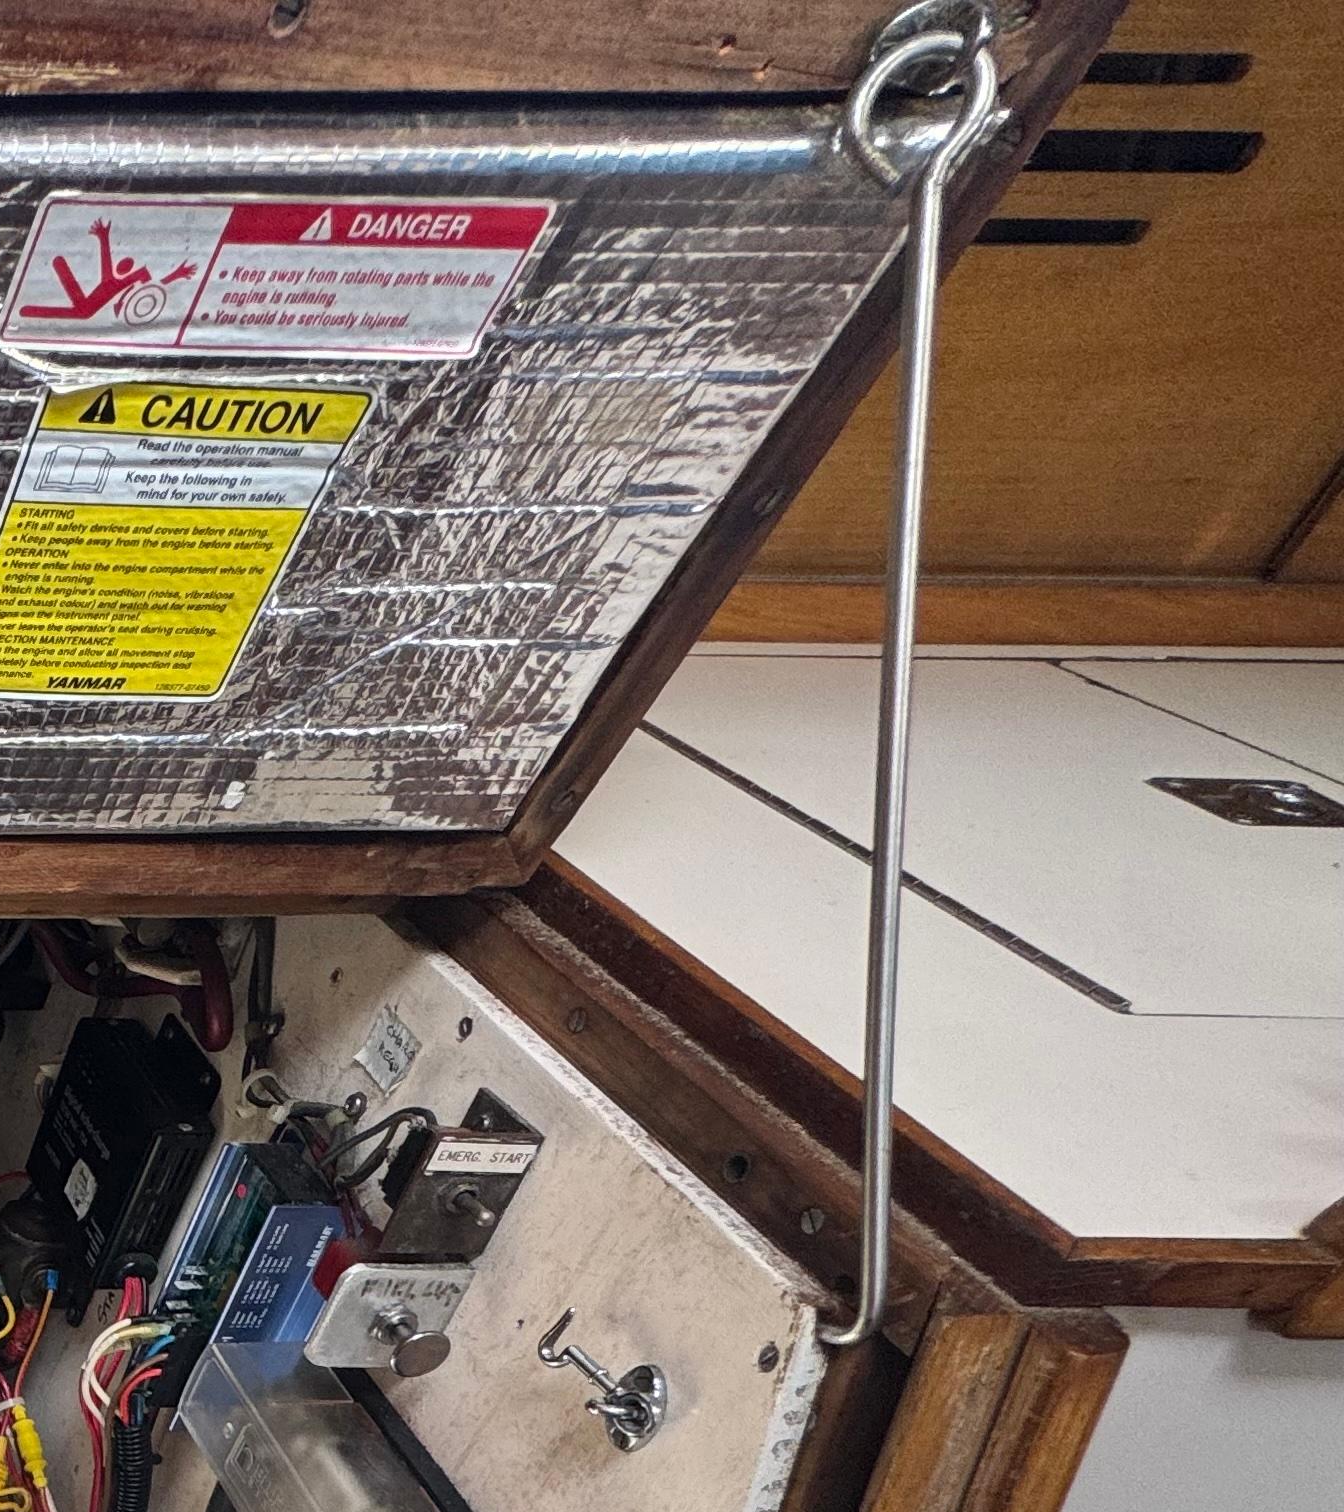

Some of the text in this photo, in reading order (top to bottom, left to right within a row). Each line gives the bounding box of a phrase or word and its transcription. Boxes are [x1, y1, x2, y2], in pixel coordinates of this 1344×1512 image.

[347, 212, 473, 242] DANGER
[232, 267, 494, 287] Keep away from rotating parts while the
[222, 290, 336, 308] engine is running.
[214, 311, 409, 329] You could be seriously injured.
[141, 395, 324, 435] CAUTION
[137, 438, 304, 459] Read the operation manual
[124, 472, 252, 489] Keep the following in
[136, 488, 287, 505] mind for your own safety.
[19, 508, 75, 519] STARTING
[40, 521, 55, 531] all
[56, 522, 88, 534] safety
[89, 523, 130, 533] devices
[132, 525, 154, 534] and
[191, 526, 225, 536] before
[228, 527, 274, 539] starting.
[19, 533, 277, 552] Keep people away from the engine before starting.
[5, 547, 70, 558] OPERATION
[9, 560, 40, 569] Never
[71, 561, 92, 571] into
[93, 562, 110, 572] the
[112, 564, 147, 575] engine
[248, 565, 266, 575] the
[39, 636, 115, 646] MAINTENANCE
[47, 677, 126, 689] YANMAR
[489, 1151, 532, 1164] START
